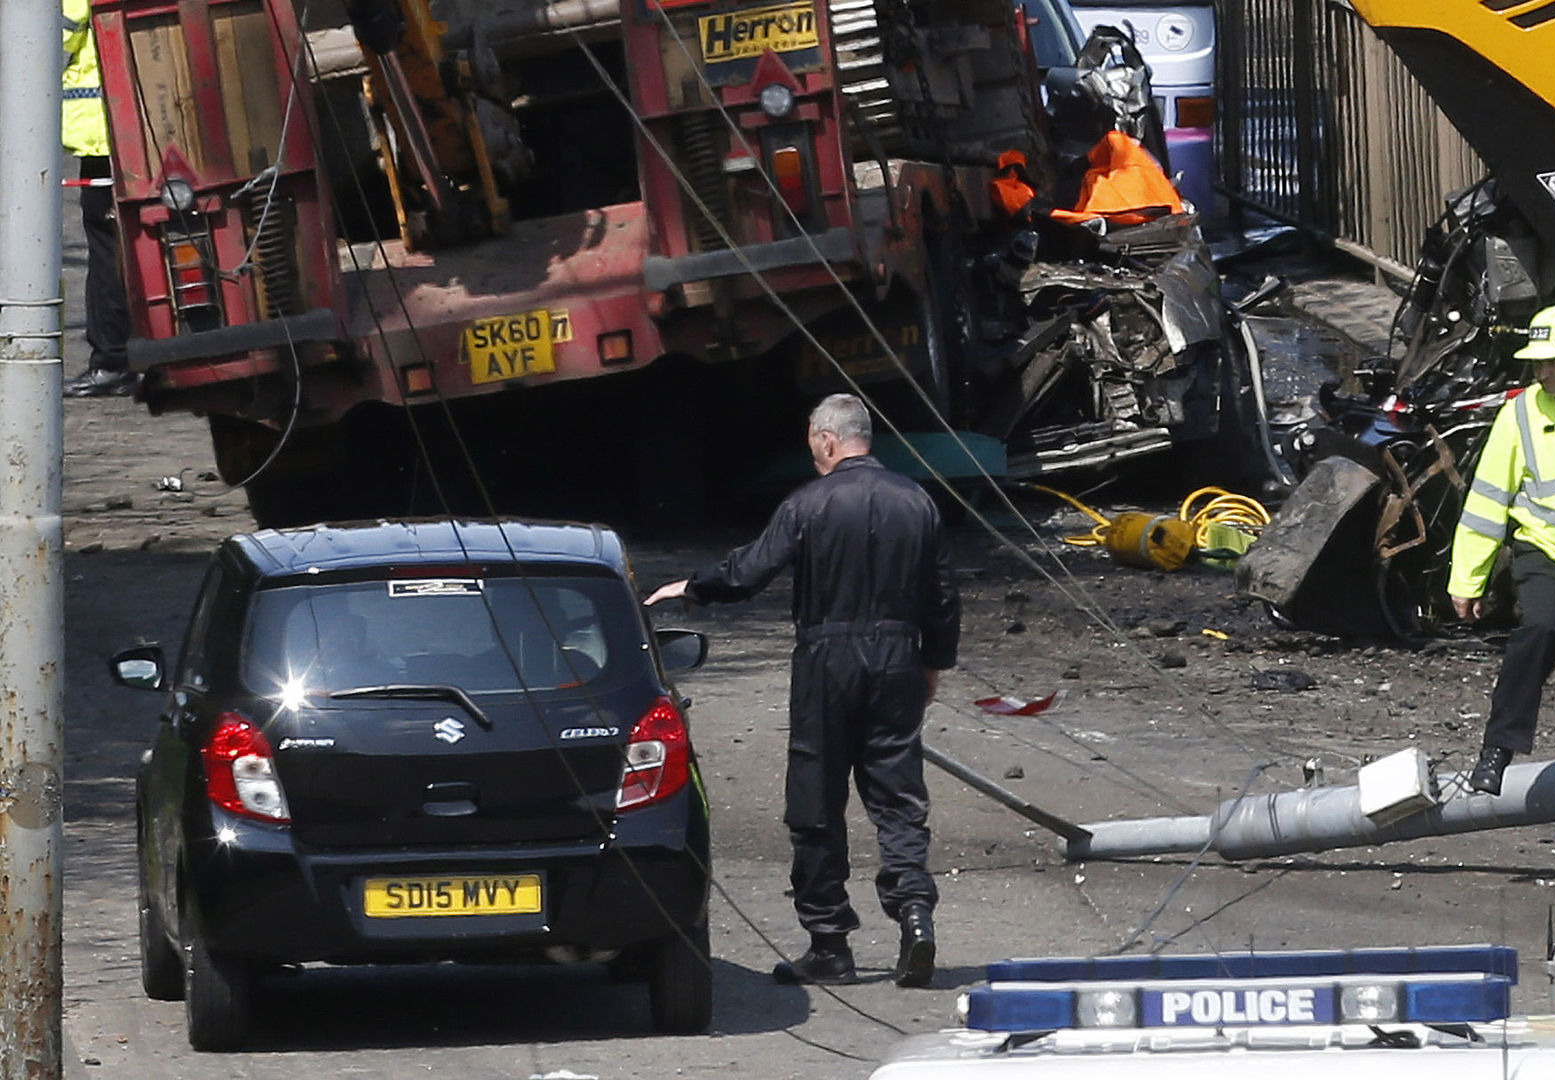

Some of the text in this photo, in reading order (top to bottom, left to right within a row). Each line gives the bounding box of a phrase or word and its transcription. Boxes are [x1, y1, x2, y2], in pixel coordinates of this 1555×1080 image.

[706, 10, 813, 54] Herron
[472, 316, 541, 348] SK60
[487, 346, 535, 377] AYF
[386, 879, 520, 909] SD15 MVY
[1161, 988, 1316, 1024] POLICE
